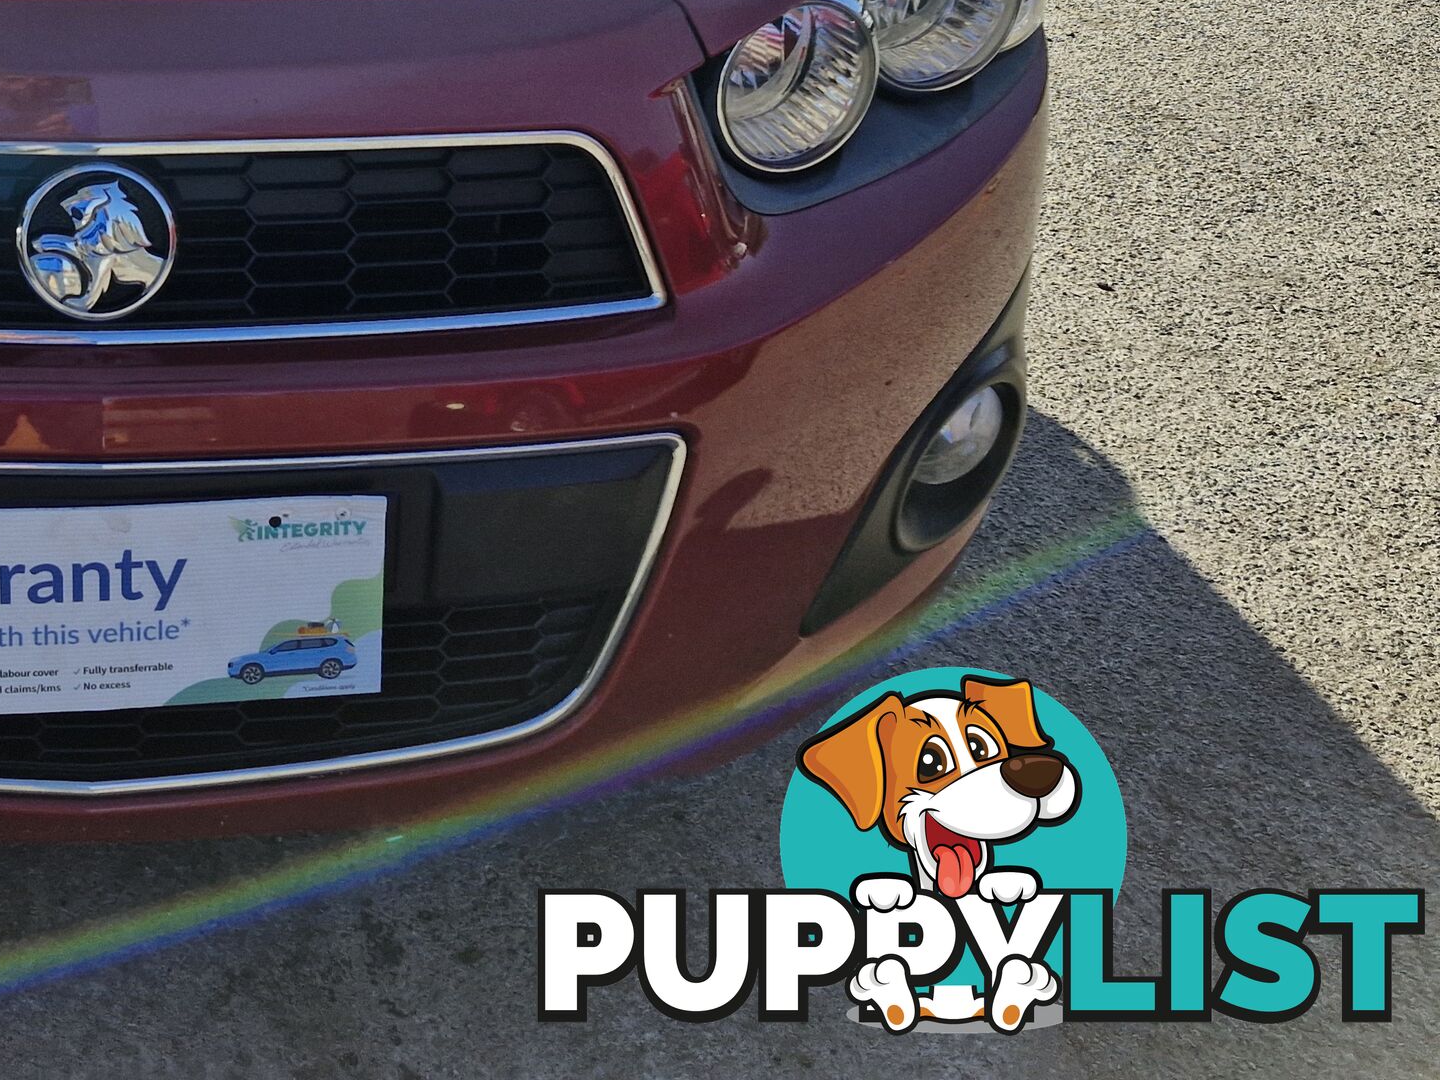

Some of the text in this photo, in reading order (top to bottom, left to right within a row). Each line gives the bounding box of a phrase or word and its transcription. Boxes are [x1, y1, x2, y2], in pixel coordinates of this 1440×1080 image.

[256, 519, 368, 540] INTEGRITY
[32, 624, 80, 646] this
[0, 668, 30, 678] labour
[32, 669, 59, 677] cover
[83, 663, 174, 676] Fully transferrable
[4, 683, 61, 694] claims/kms
[83, 681, 131, 691] No excess
